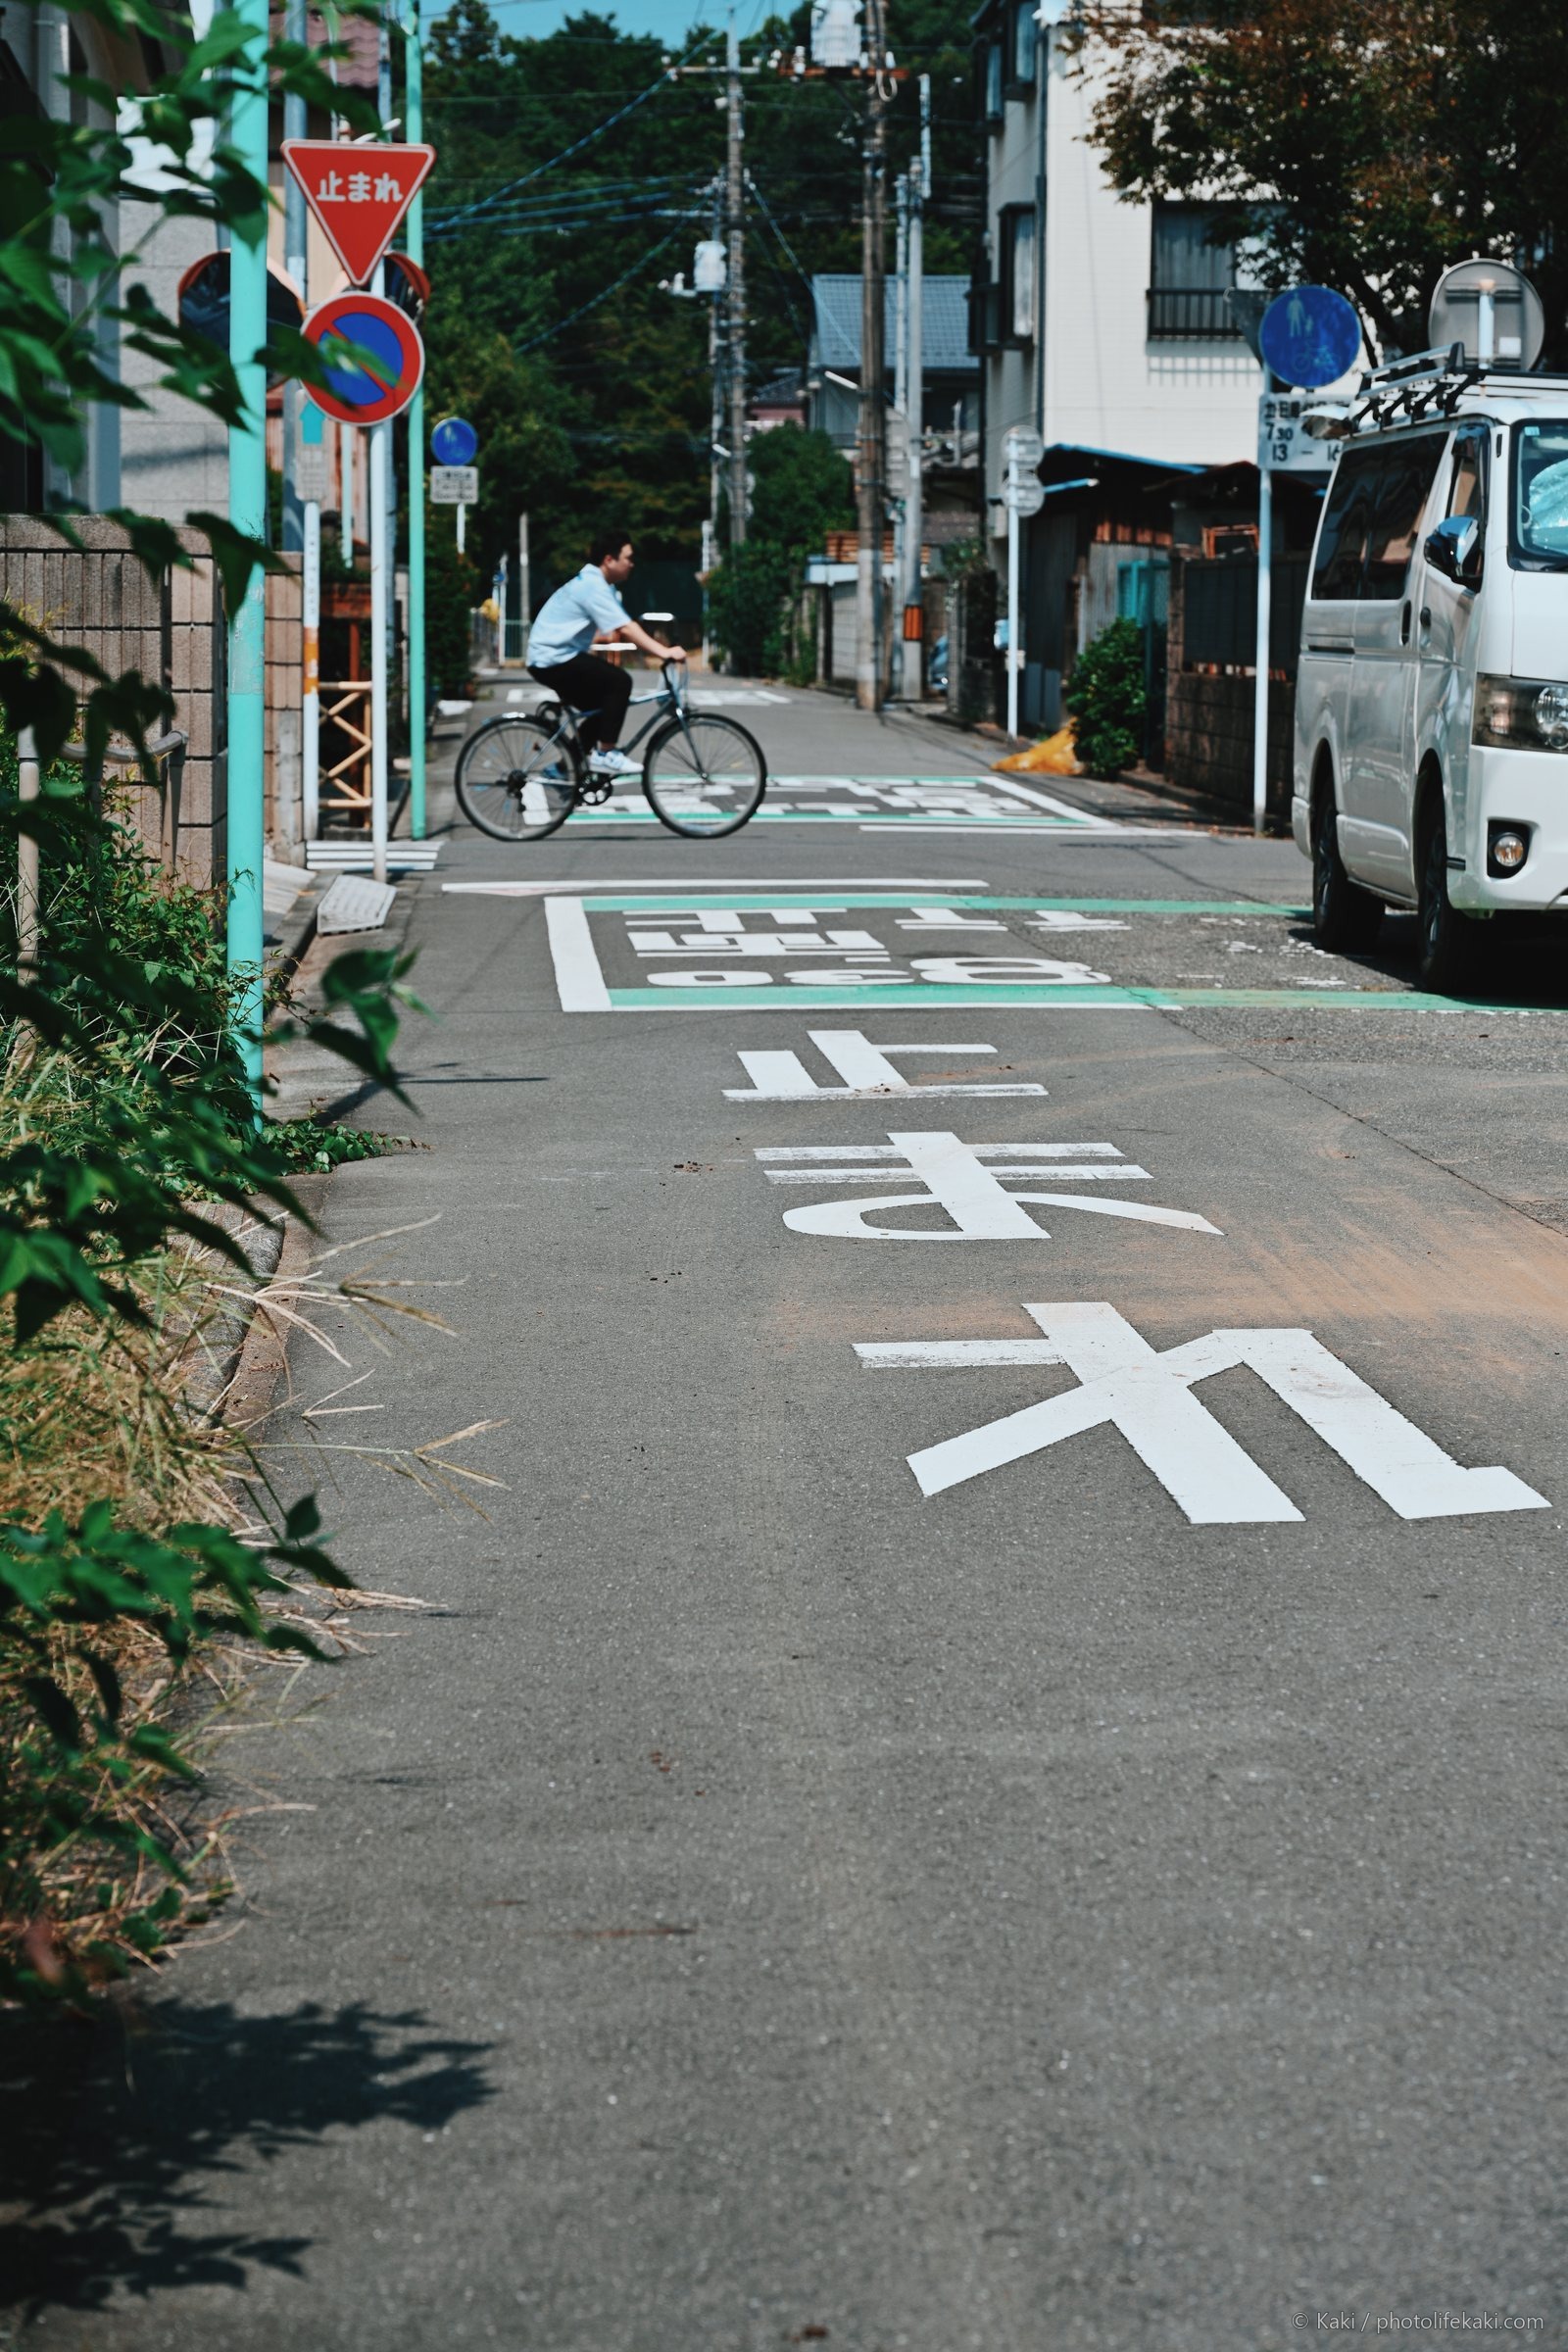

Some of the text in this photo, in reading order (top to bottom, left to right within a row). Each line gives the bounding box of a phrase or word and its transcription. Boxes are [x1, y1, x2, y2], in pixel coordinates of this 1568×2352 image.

[316, 170, 403, 203] 止まれ
[1272, 443, 1288, 462] 13
[721, 1029, 1552, 1524] 止まれ
